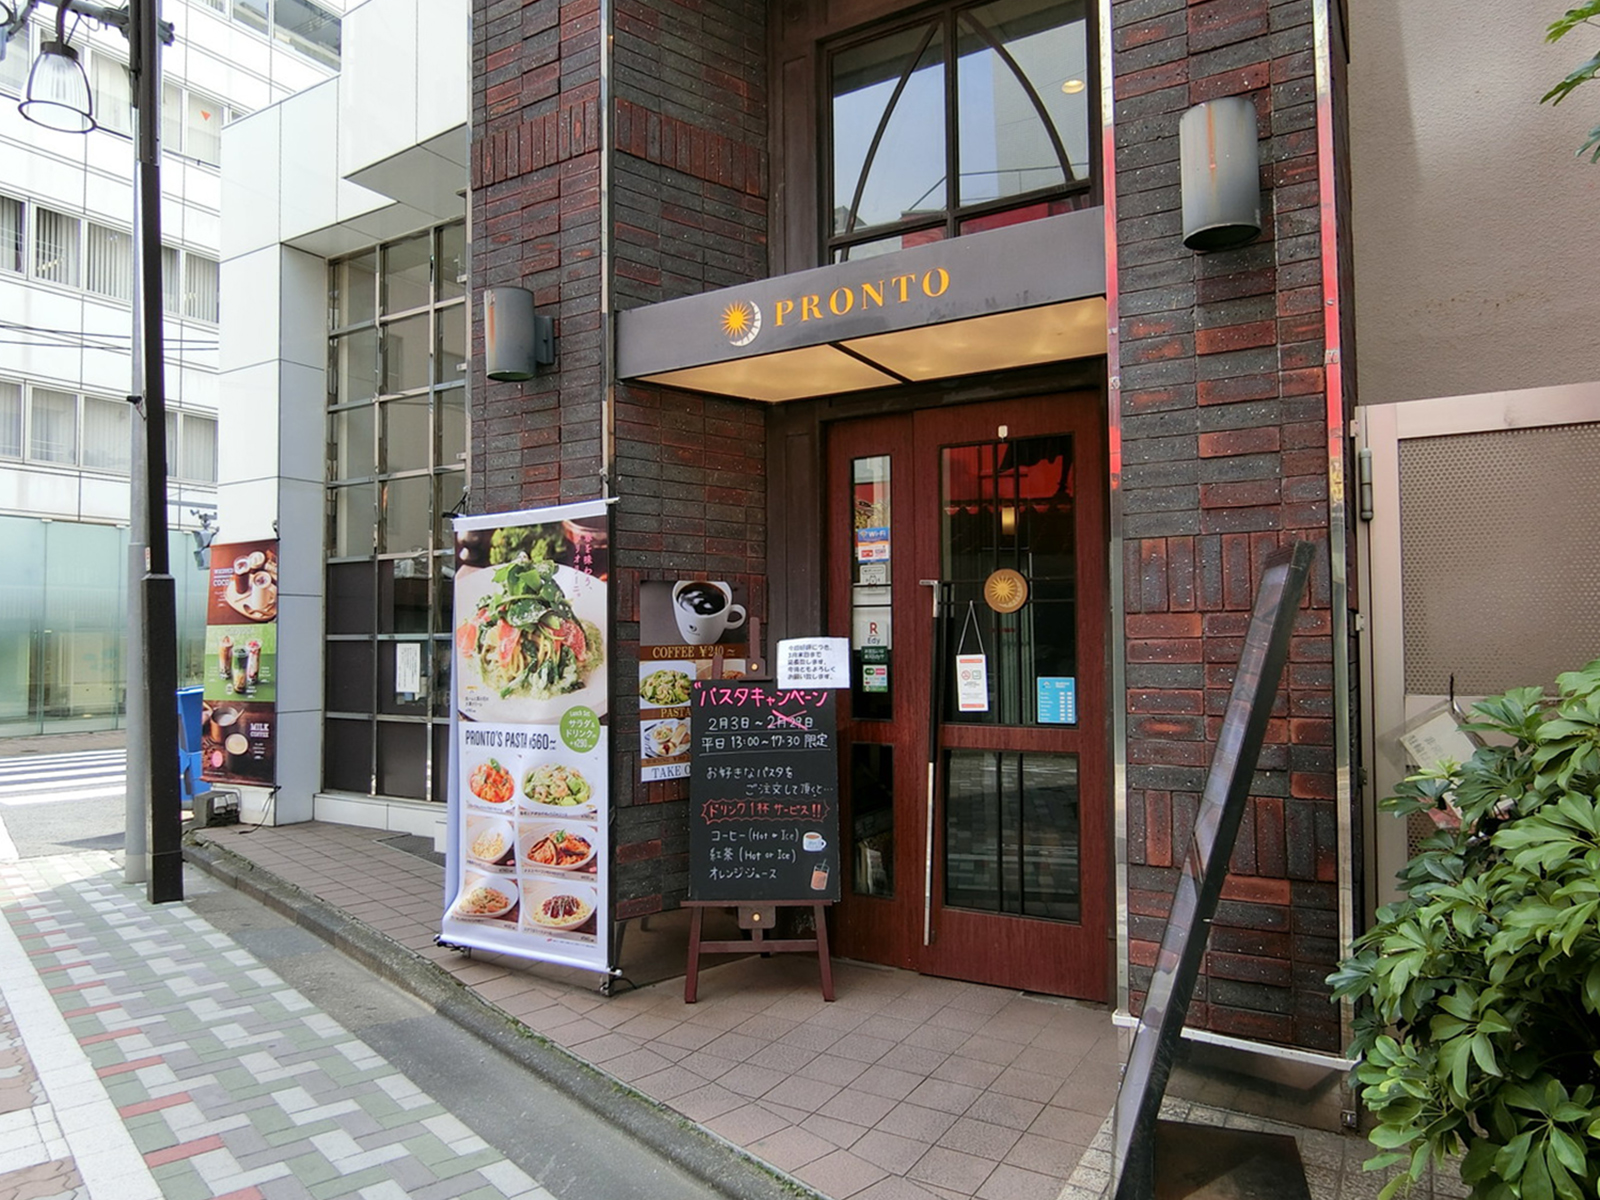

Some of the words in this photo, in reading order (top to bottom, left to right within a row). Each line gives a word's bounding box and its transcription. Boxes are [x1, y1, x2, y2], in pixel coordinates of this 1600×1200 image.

[775, 267, 950, 326] PRONTO
[869, 622, 878, 634] R
[867, 637, 881, 645] Edy
[652, 645, 695, 659] COFFEE
[661, 707, 692, 718] PASTA
[250, 723, 269, 731] MILK
[708, 717, 750, 731] 2月3日
[465, 730, 503, 748] PRONTO'S
[505, 732, 528, 749] PASTA
[701, 736, 725, 752] 平日
[804, 732, 828, 748] 限定
[652, 765, 682, 779] TAKE
[706, 766, 793, 780] お好きなパスタを
[709, 847, 734, 862] 紅茶
[709, 866, 777, 881] オレンジジュース
